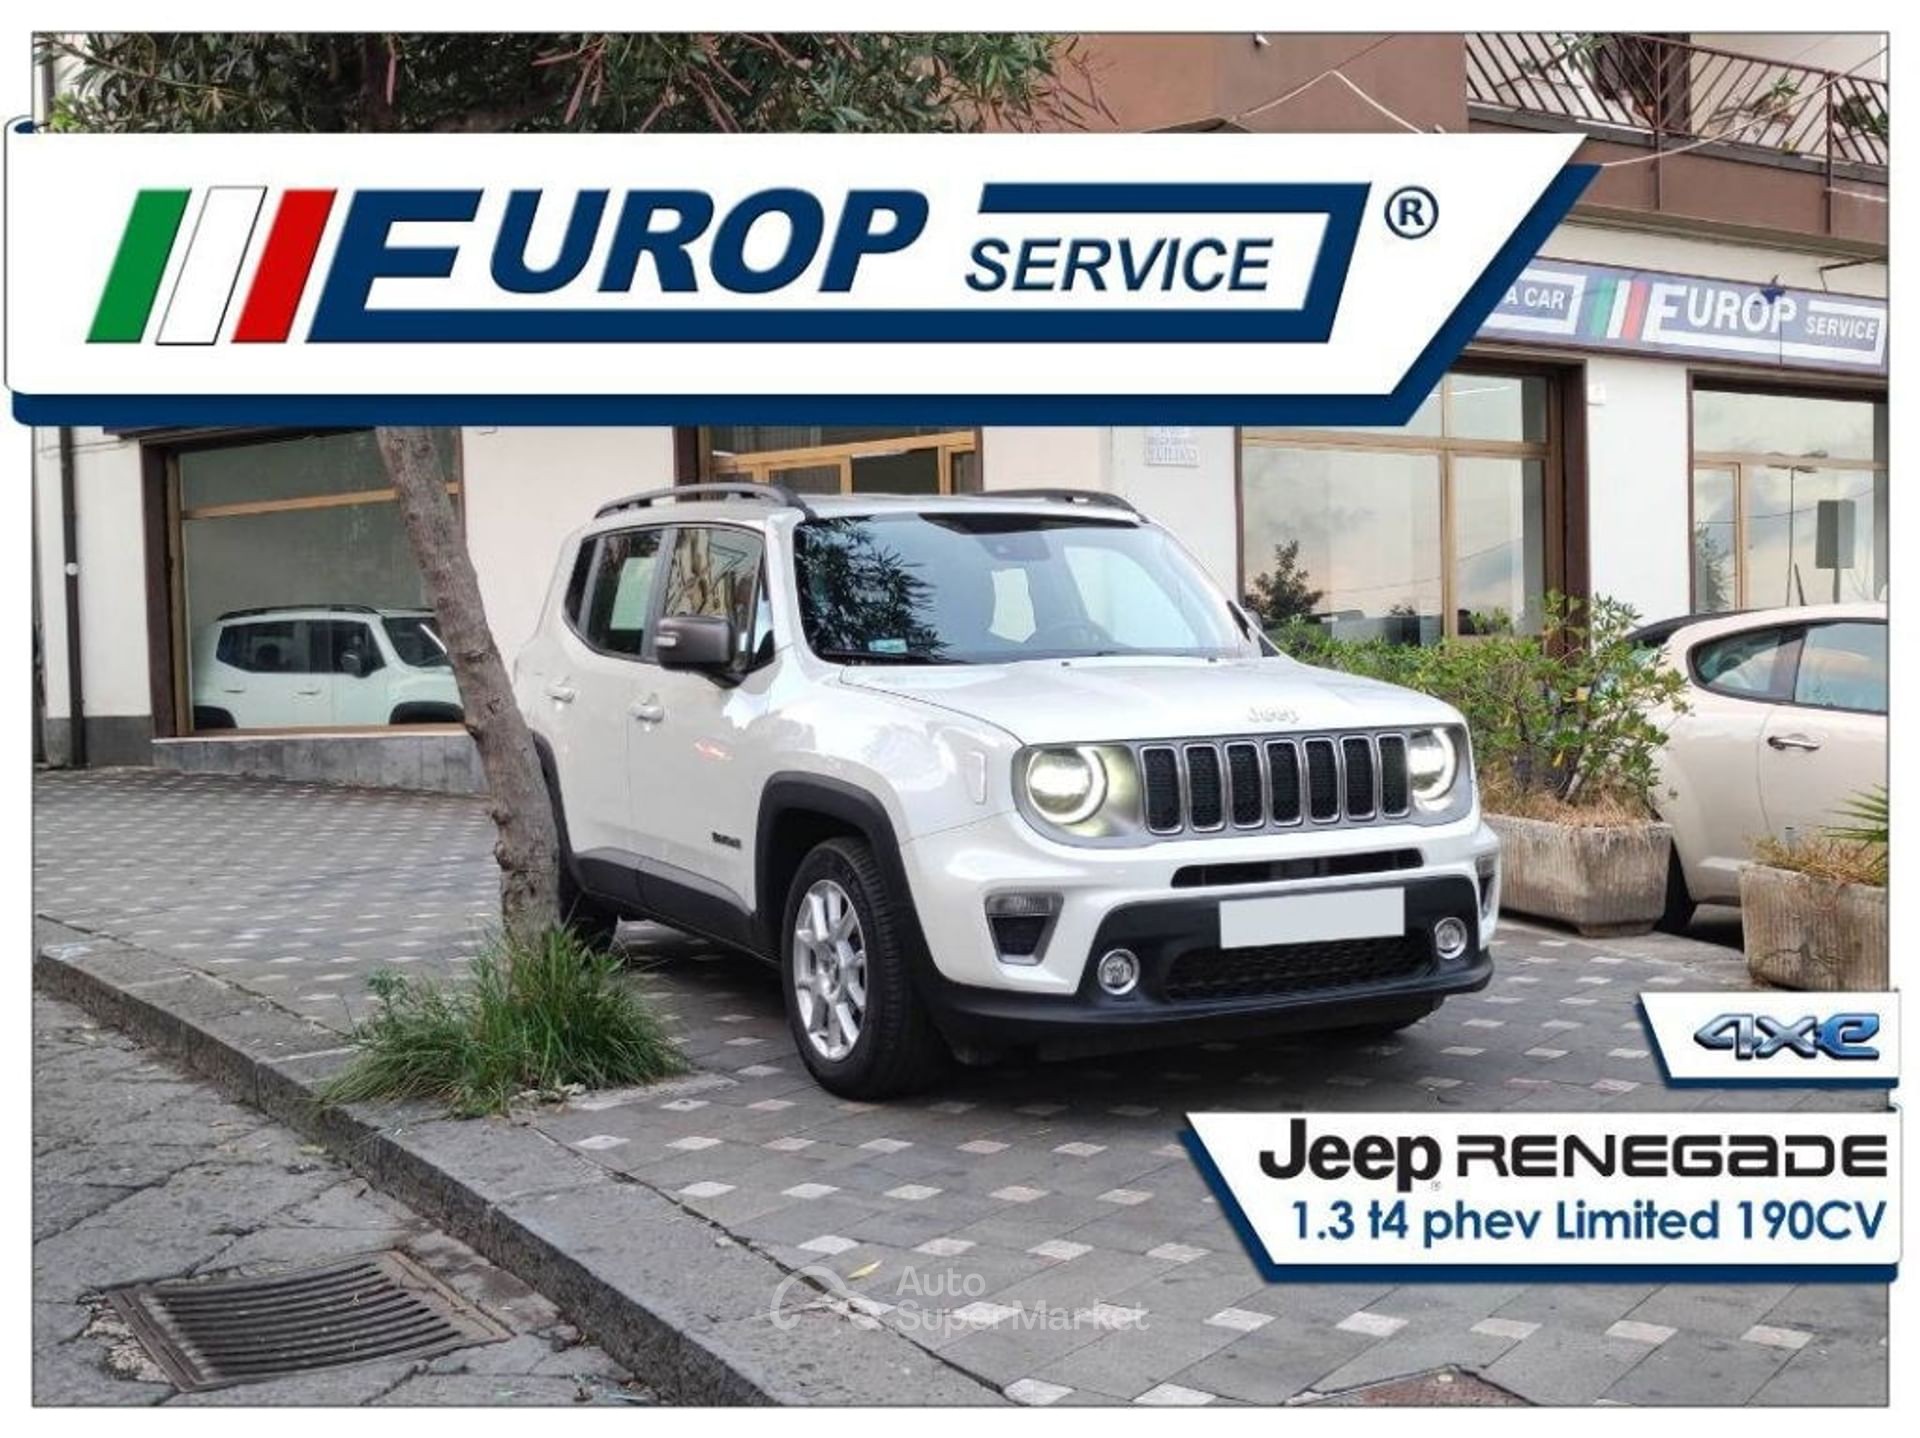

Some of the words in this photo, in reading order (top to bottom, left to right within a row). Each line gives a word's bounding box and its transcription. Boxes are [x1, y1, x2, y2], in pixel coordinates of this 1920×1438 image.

[1524, 287, 1565, 310] CAR
[1642, 281, 1798, 342] EUROP
[1805, 315, 1877, 341] SERVICE
